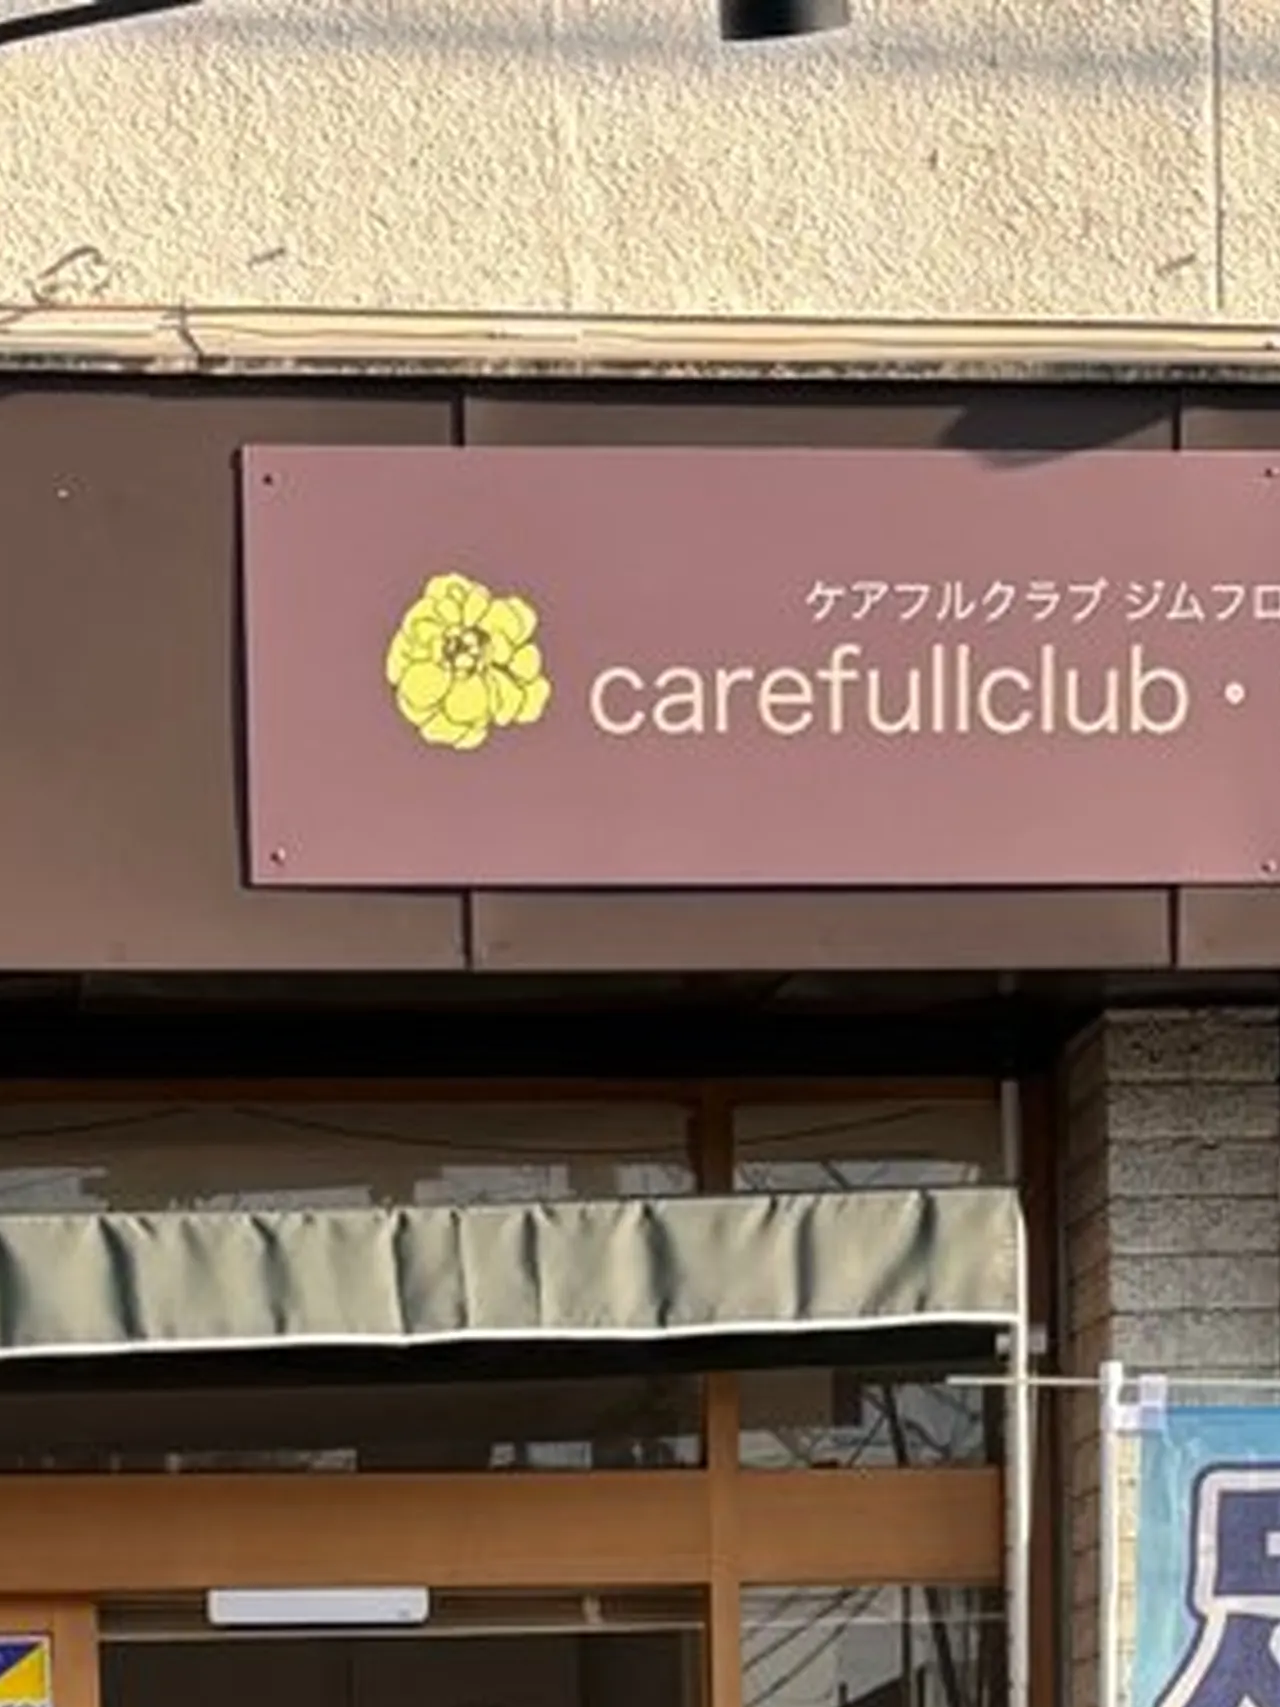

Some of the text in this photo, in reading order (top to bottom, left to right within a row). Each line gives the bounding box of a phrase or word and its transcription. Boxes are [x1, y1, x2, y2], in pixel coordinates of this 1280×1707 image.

[806, 577, 1108, 622] ケアフルクラブ
[590, 643, 1190, 735] carefullclub
